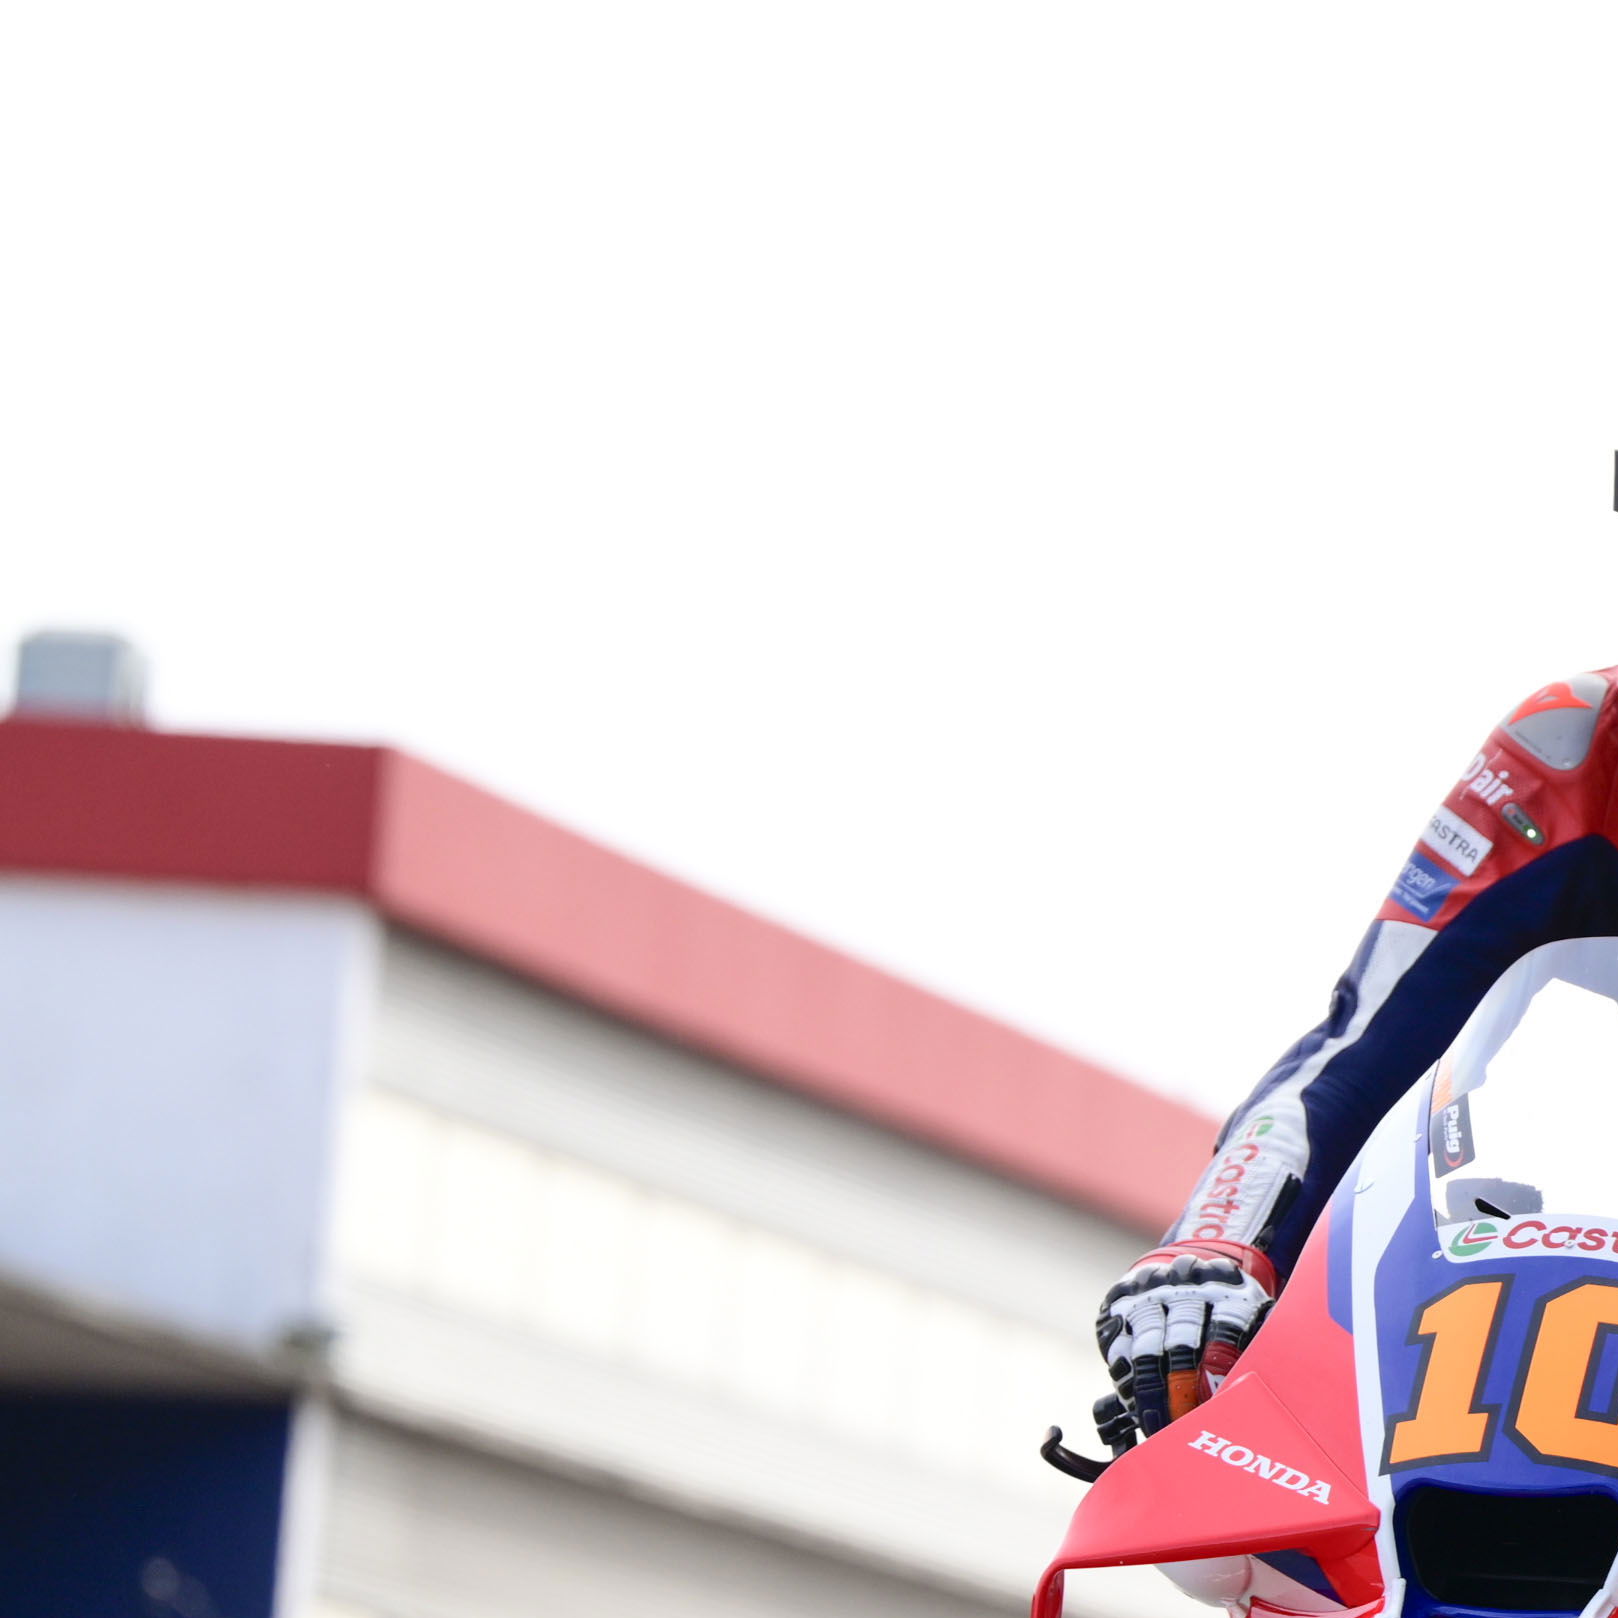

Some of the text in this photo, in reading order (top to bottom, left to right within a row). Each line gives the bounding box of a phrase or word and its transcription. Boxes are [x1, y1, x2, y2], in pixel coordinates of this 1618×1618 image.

[1445, 1104, 1463, 1154] Puig
[1192, 1143, 1260, 1241] Castro
[1187, 1430, 1334, 1505] HONDA
